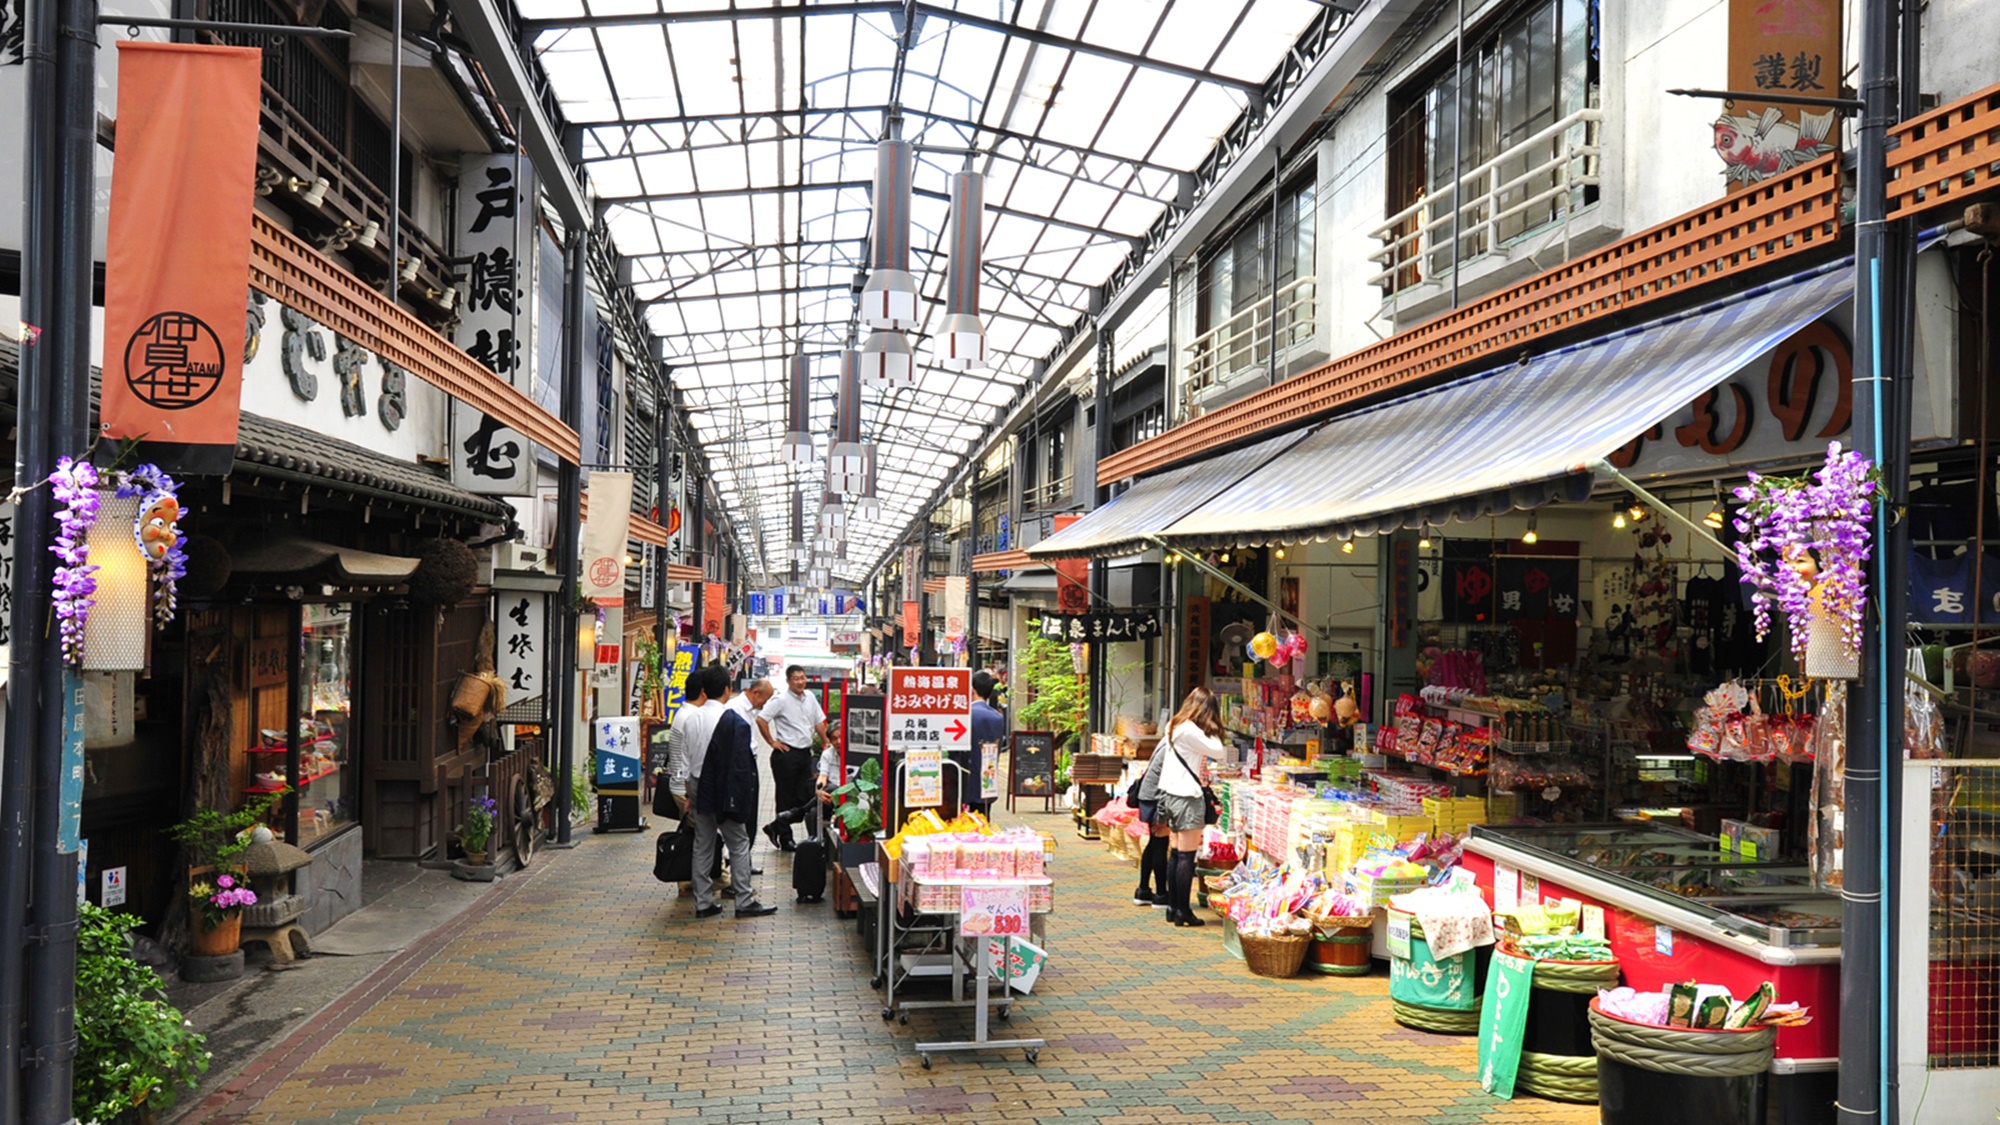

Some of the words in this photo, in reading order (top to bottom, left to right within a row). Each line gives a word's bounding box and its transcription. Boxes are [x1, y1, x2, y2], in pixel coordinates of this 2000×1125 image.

[1752, 51, 1825, 91] 謹製
[187, 361, 220, 374] ATAMI
[1456, 565, 1492, 605] ゆ
[1524, 568, 1550, 594] ゆ
[1501, 590, 1522, 612] 男
[1553, 593, 1575, 613] 女
[835, 633, 858, 642] くすり
[903, 675, 959, 690] 熱海温泉
[893, 693, 969, 710] おみやげ処
[892, 729, 940, 741] 高橋商店
[985, 904, 1022, 915] せんべい
[994, 914, 1021, 934] 530
